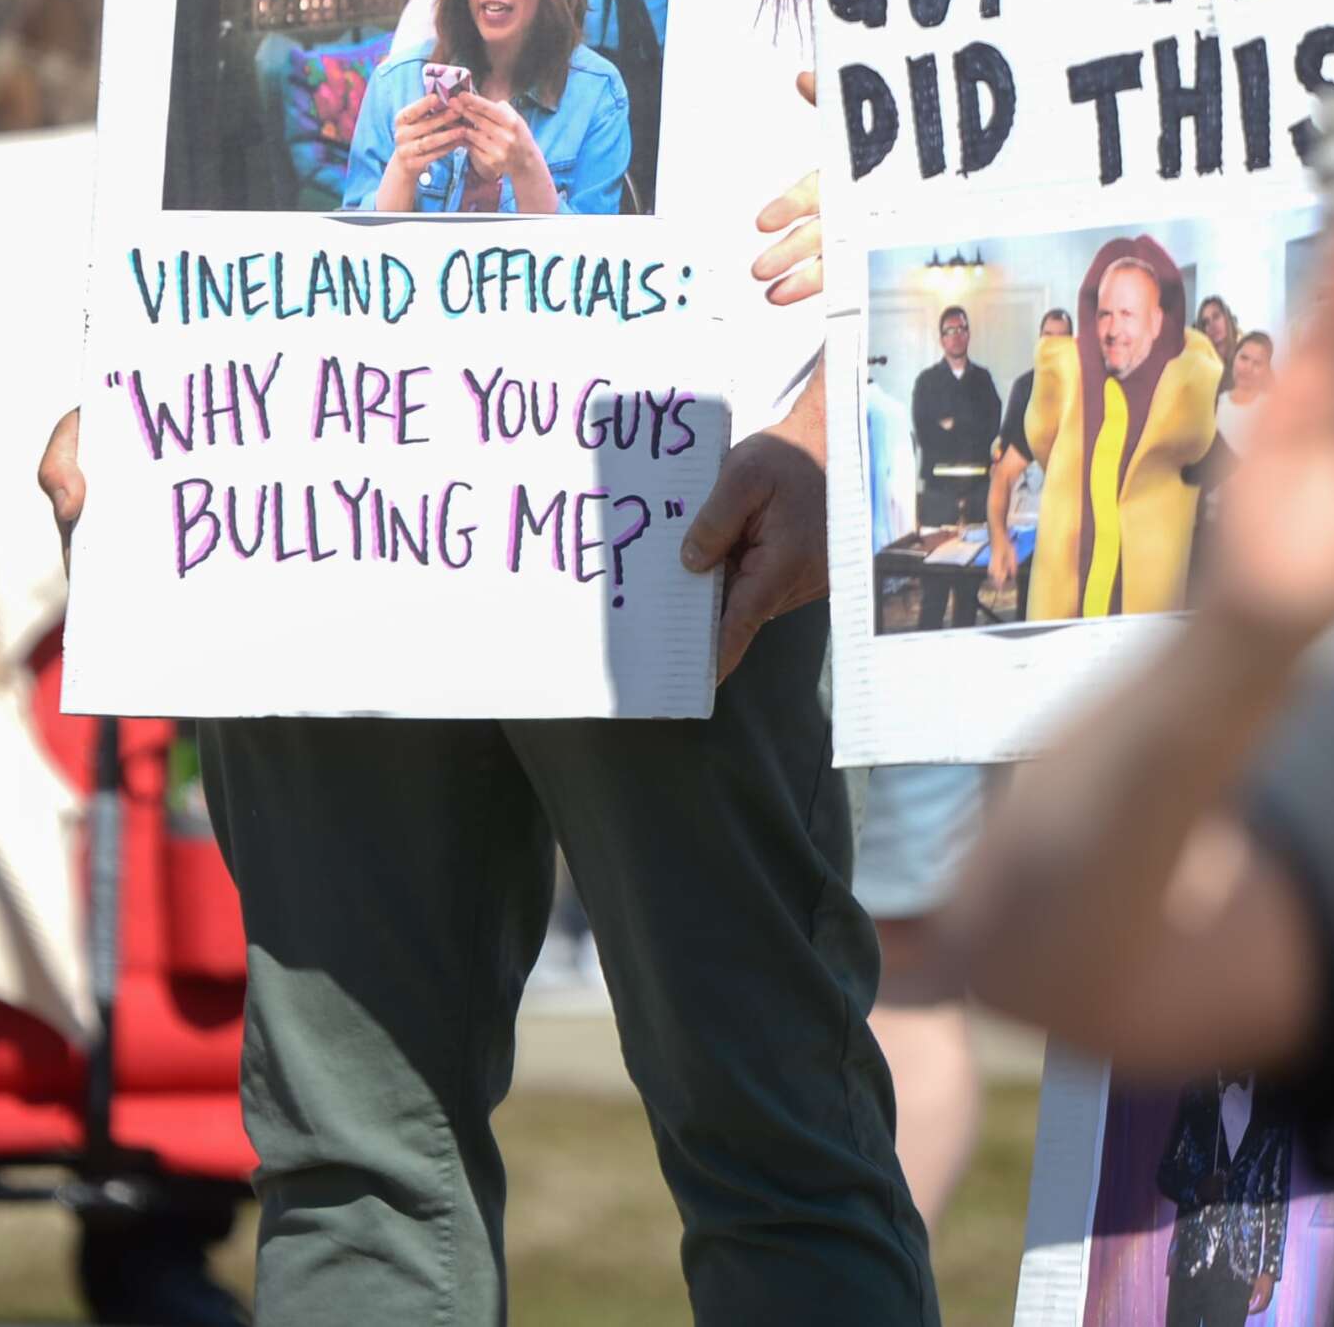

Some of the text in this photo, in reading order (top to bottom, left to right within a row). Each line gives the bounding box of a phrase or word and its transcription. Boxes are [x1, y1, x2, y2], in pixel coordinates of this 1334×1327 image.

[838, 40, 1018, 181] DID
[126, 246, 694, 325] VINELAND OFFICIALS:
[105, 352, 697, 460] "WHY ARE YOU GUYS
[172, 476, 686, 610] BULLYING ME?"
